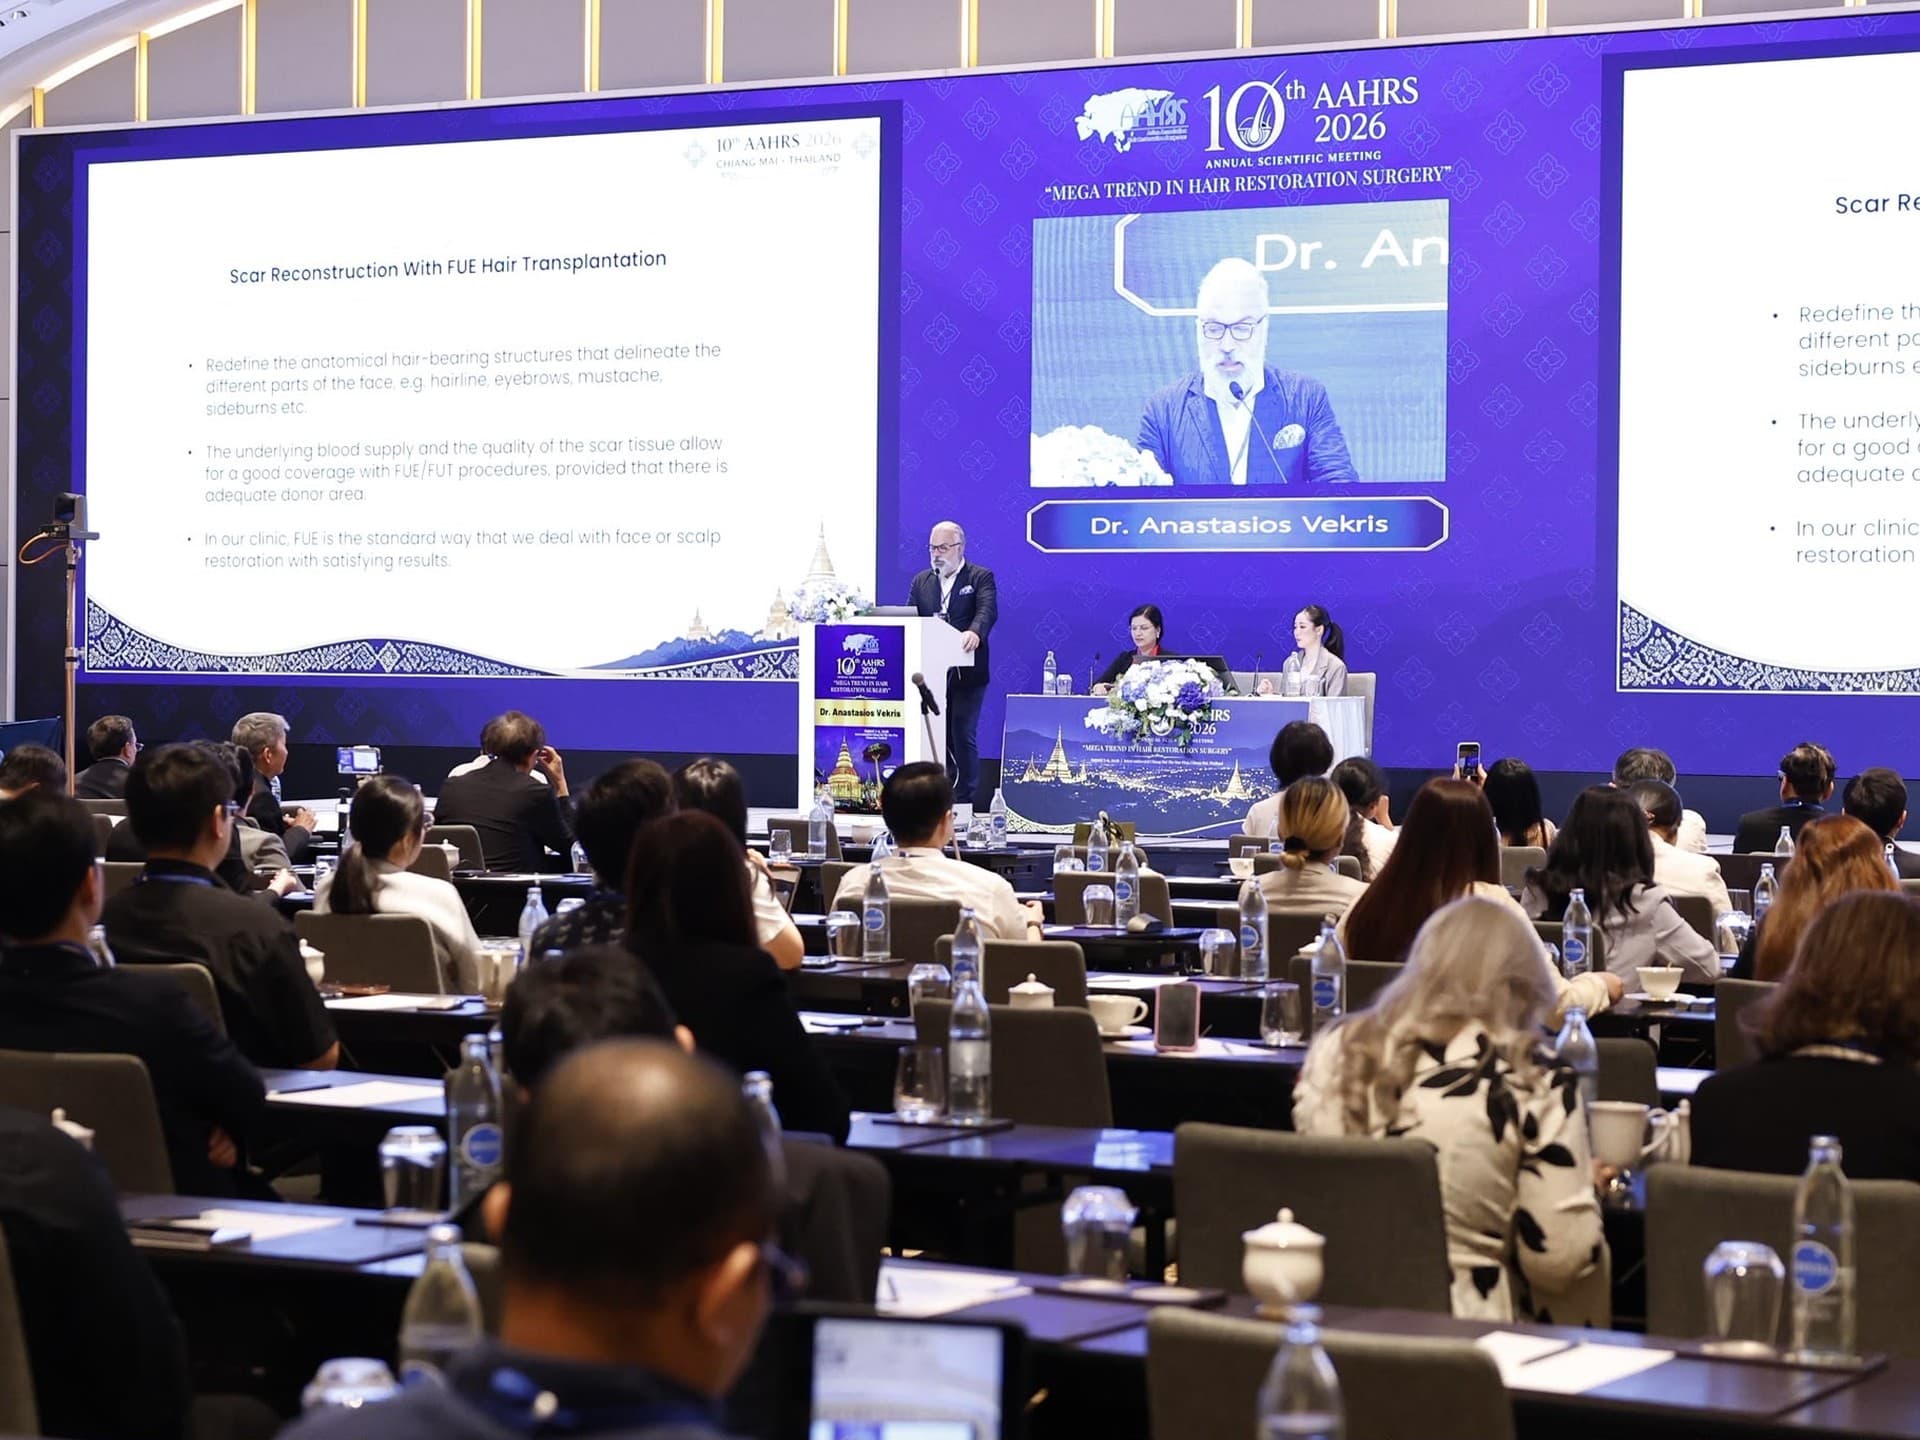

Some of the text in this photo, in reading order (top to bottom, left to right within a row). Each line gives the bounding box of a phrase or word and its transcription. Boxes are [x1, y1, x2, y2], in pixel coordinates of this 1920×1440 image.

[1312, 76, 1419, 109] AAHRS
[1315, 112, 1386, 142] 2026
[743, 134, 800, 151] AAHRS
[716, 157, 756, 169] CHIANG
[788, 152, 842, 164] THAILAND
[1205, 150, 1382, 169] ANNUAL SCIENTIFIC MEETING
[1104, 180, 1161, 199] TREND
[1166, 179, 1184, 195] IN
[1188, 176, 1231, 194] HAIR
[1235, 171, 1358, 192] RESTORATION
[1836, 197, 1890, 214] Scar
[1255, 228, 1449, 272] Dr. An
[231, 250, 666, 283] Scar Reconstruction With FUE Hair Transplantation
[1799, 303, 1894, 323] Redefine
[1799, 331, 1890, 350] different
[207, 344, 720, 371] Redefine the anatomical hair-bearing structures that delineate the
[1799, 358, 1905, 377] sideburns
[206, 378, 266, 394] different
[272, 379, 308, 395] parts
[313, 376, 326, 390] of
[332, 377, 355, 390] the
[495, 371, 572, 389] eyebrows,
[579, 368, 662, 383] mustache,
[207, 401, 307, 416] sideburns etc.
[1798, 412, 1837, 430] The
[207, 436, 722, 462] The underlying blood supply and the quality of the scar tissue allow
[1798, 437, 1910, 462] for a good
[206, 457, 728, 485] for a good coverage with FUE/FUT procedures, provided that there is
[1797, 466, 1905, 488] adequate
[205, 488, 366, 504] adequate donor area.
[1090, 514, 1388, 535] Dr. Anastasios Vekris
[1796, 520, 1815, 537] In
[1821, 523, 1857, 537] our
[205, 533, 217, 544] In
[222, 535, 244, 546] our
[294, 532, 318, 545] FUE
[323, 531, 336, 545] is
[339, 532, 362, 544] the
[367, 531, 436, 545] standard
[441, 533, 471, 548] way
[477, 531, 507, 544] that
[512, 533, 534, 544] we
[539, 530, 573, 544] deal
[579, 530, 610, 543] with
[616, 529, 651, 543] face
[656, 532, 671, 543] or
[677, 530, 720, 546] scalp
[205, 554, 283, 567] restoration
[289, 553, 318, 567] with
[323, 553, 393, 572] satisfying
[1796, 545, 1915, 564] restoration
[861, 659, 885, 667] AAHRS
[861, 667, 878, 675] 2026
[820, 708, 901, 718] Dr. Anastasios Vekris
